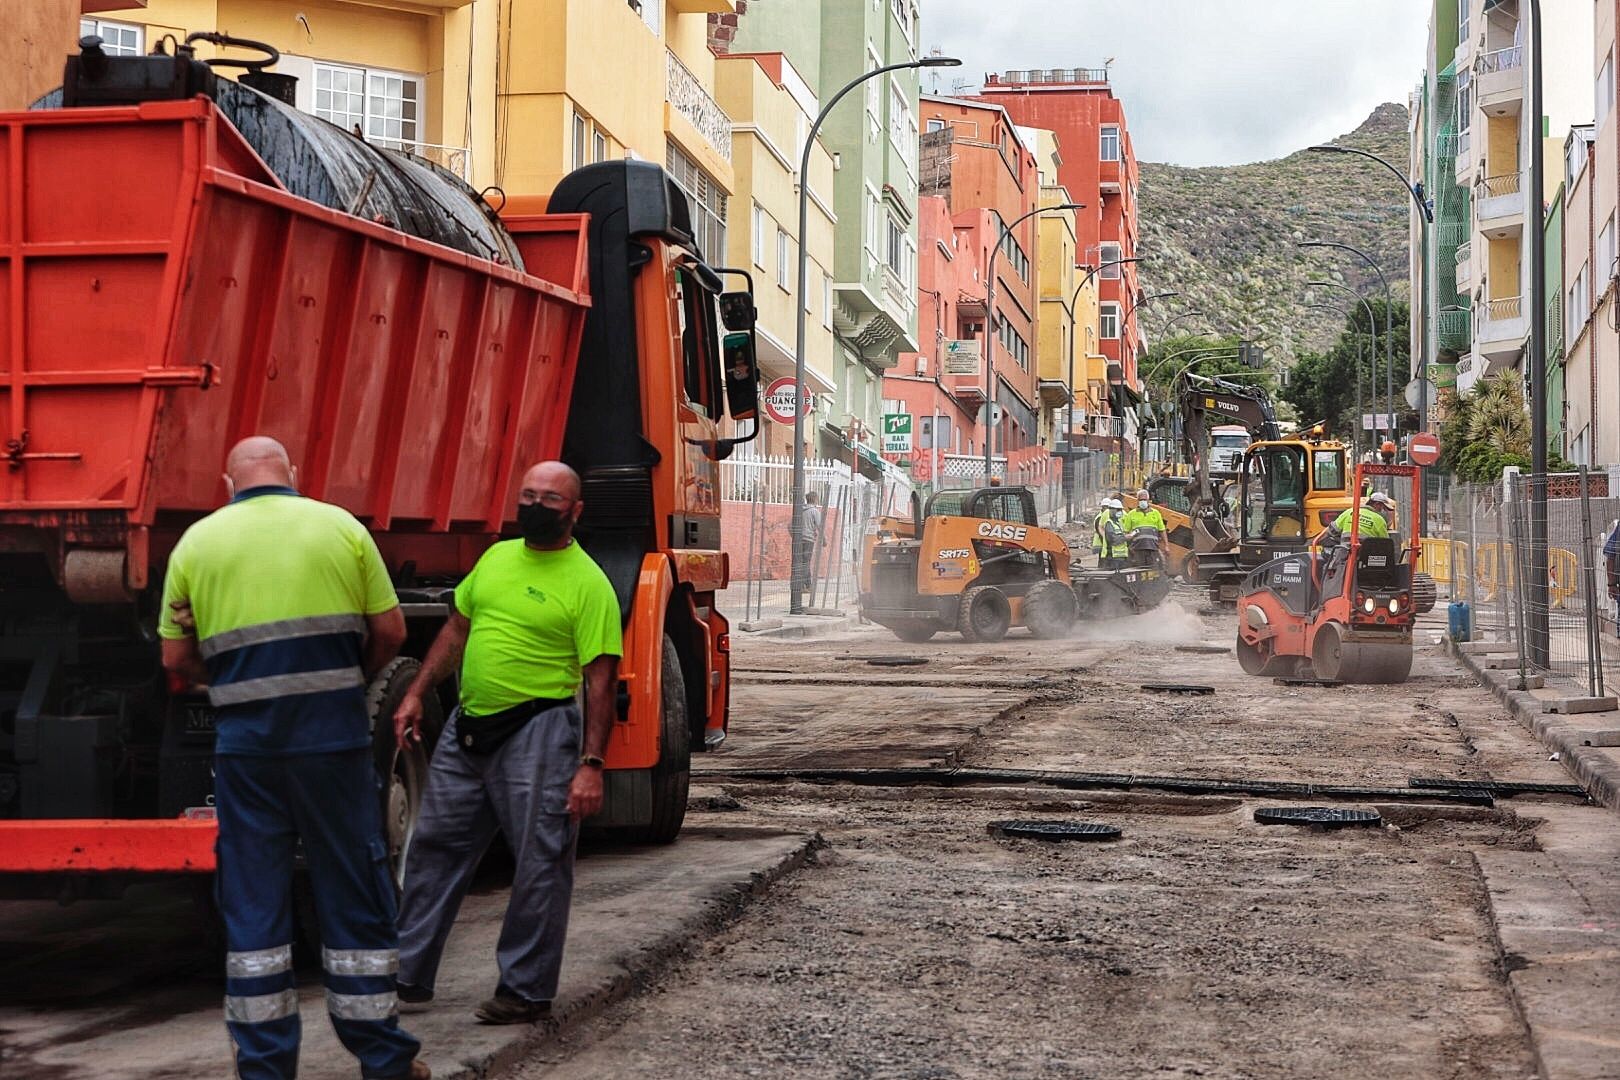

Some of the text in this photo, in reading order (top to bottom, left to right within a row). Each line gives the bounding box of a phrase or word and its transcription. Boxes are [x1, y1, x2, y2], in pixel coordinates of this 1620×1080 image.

[765, 396, 811, 405] GUANCE
[1217, 401, 1240, 412] VOLVO
[886, 443, 910, 451] TERRAZA
[978, 522, 1028, 541] CASE
[939, 549, 970, 559] SR175
